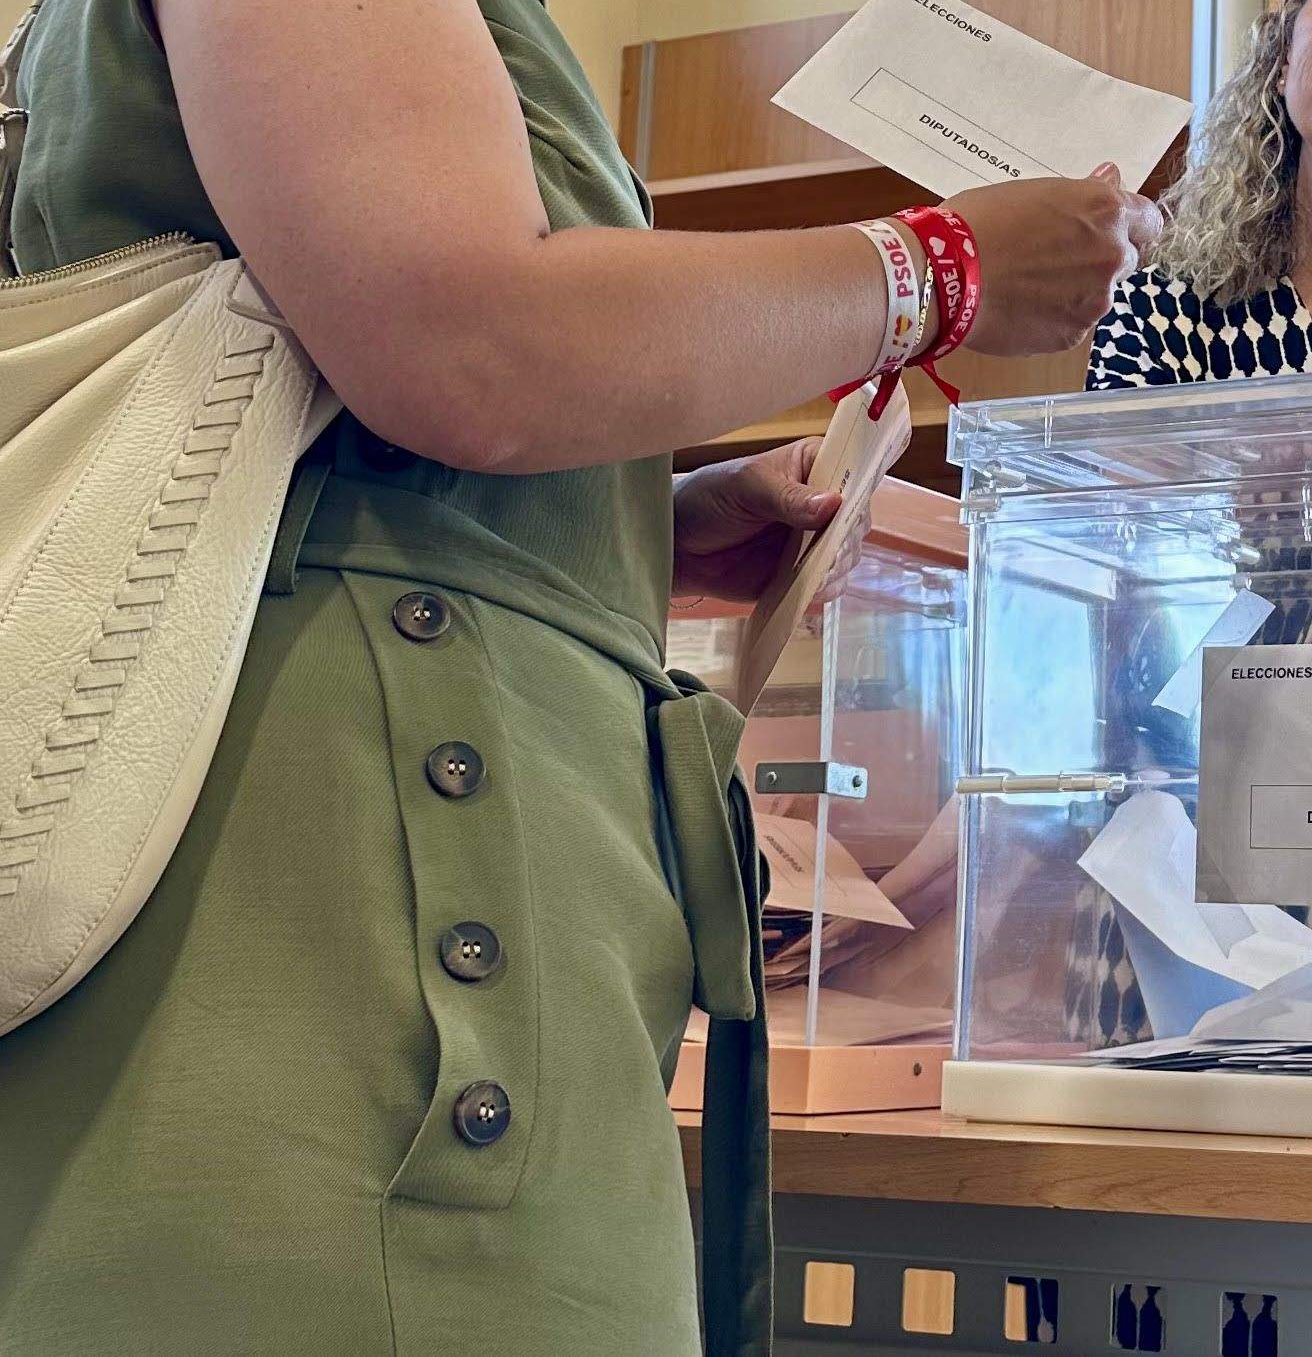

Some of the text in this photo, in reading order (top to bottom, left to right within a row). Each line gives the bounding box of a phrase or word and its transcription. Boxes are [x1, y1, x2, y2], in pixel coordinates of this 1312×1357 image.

[919, 113, 1021, 179] DIPUTADOS/AS
[881, 237, 914, 298] PSOE
[1231, 666, 1312, 680] ELECCIONES
